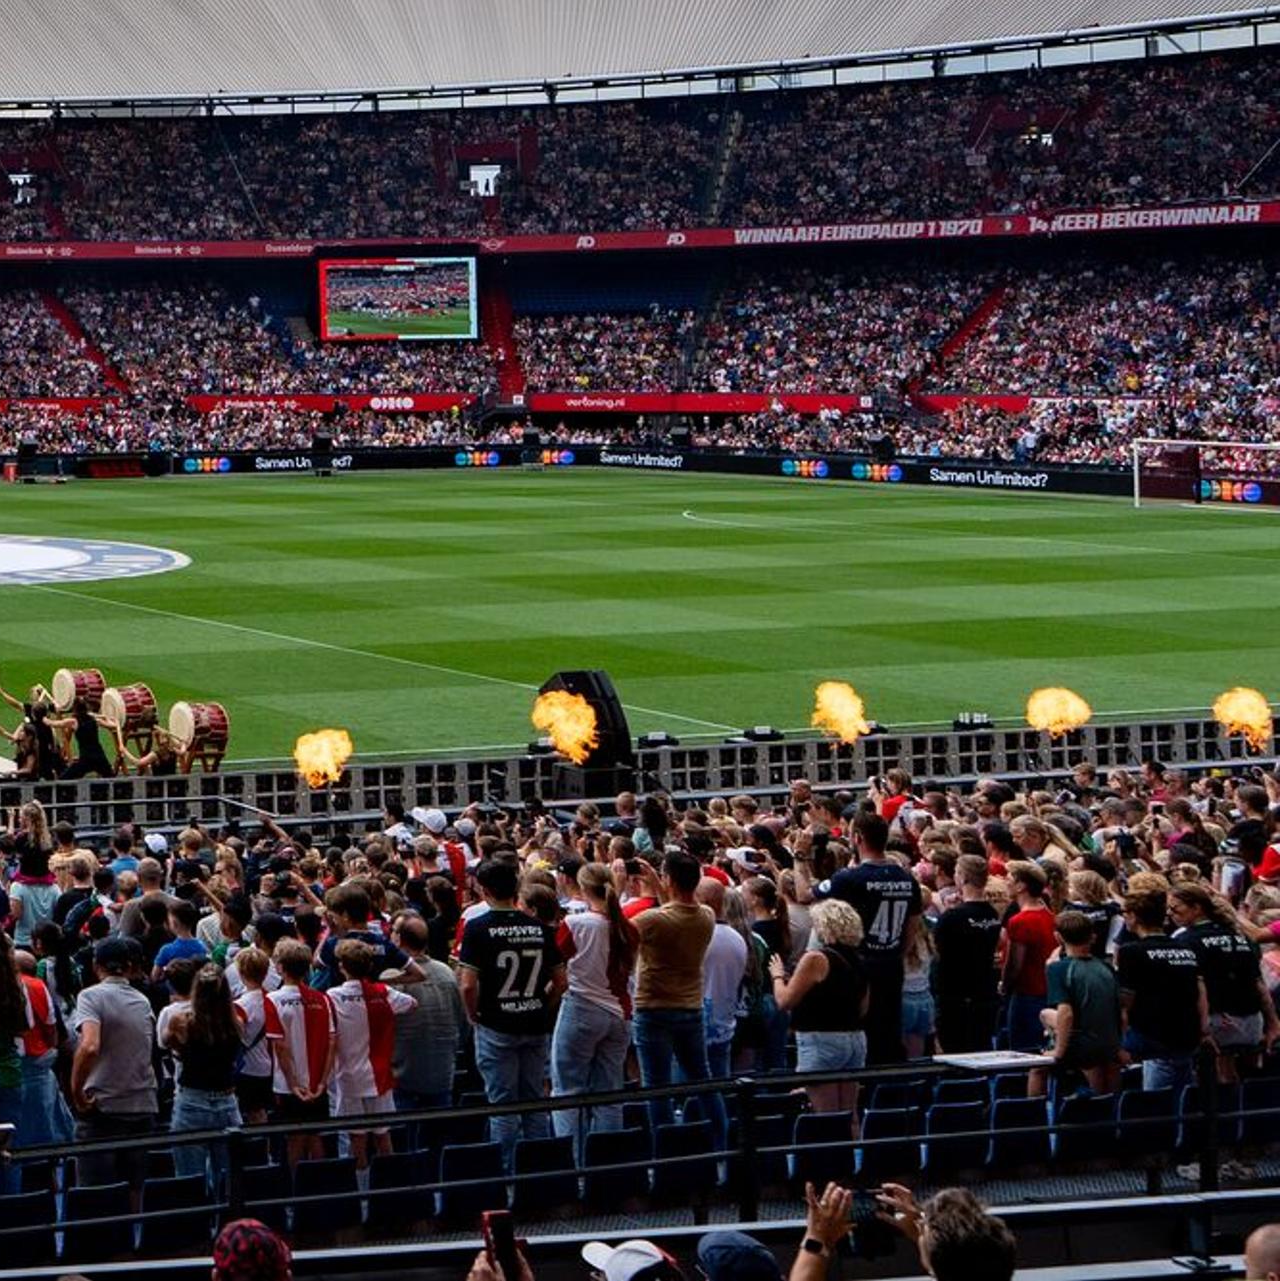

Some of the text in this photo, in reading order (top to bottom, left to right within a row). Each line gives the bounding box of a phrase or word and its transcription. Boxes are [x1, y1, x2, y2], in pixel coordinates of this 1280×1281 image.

[1051, 209, 1097, 231] KEER
[1100, 205, 1261, 228] BEKERWINNAAR
[666, 232, 686, 245] AD
[734, 225, 819, 245] WINNAAR
[821, 222, 922, 241] EUROPACUP
[938, 217, 983, 237] 1970
[576, 235, 595, 248] AD
[256, 457, 295, 469] Samen
[600, 452, 683, 468] Samen Unlimited?
[929, 468, 1048, 487] Samen Unlimited?
[497, 949, 544, 999] 27
